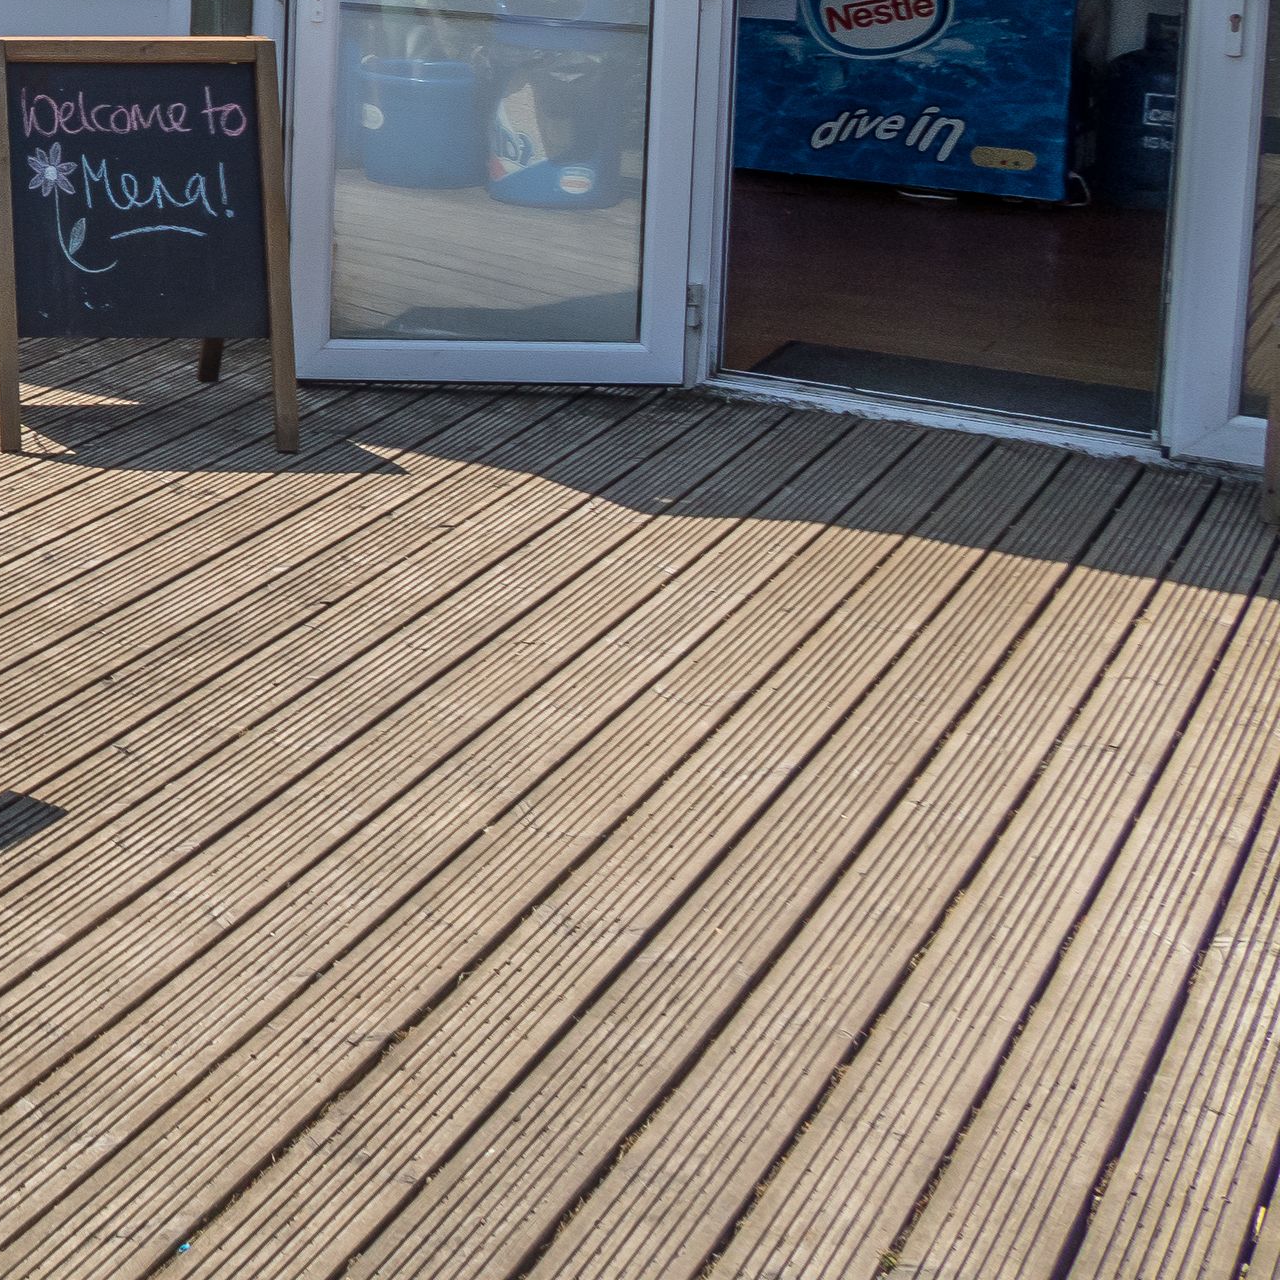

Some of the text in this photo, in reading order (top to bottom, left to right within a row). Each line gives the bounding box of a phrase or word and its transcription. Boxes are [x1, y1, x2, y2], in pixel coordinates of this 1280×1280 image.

[21, 86, 247, 138] Welcome to
[811, 106, 966, 162] dive in
[81, 154, 235, 218] Mena!
